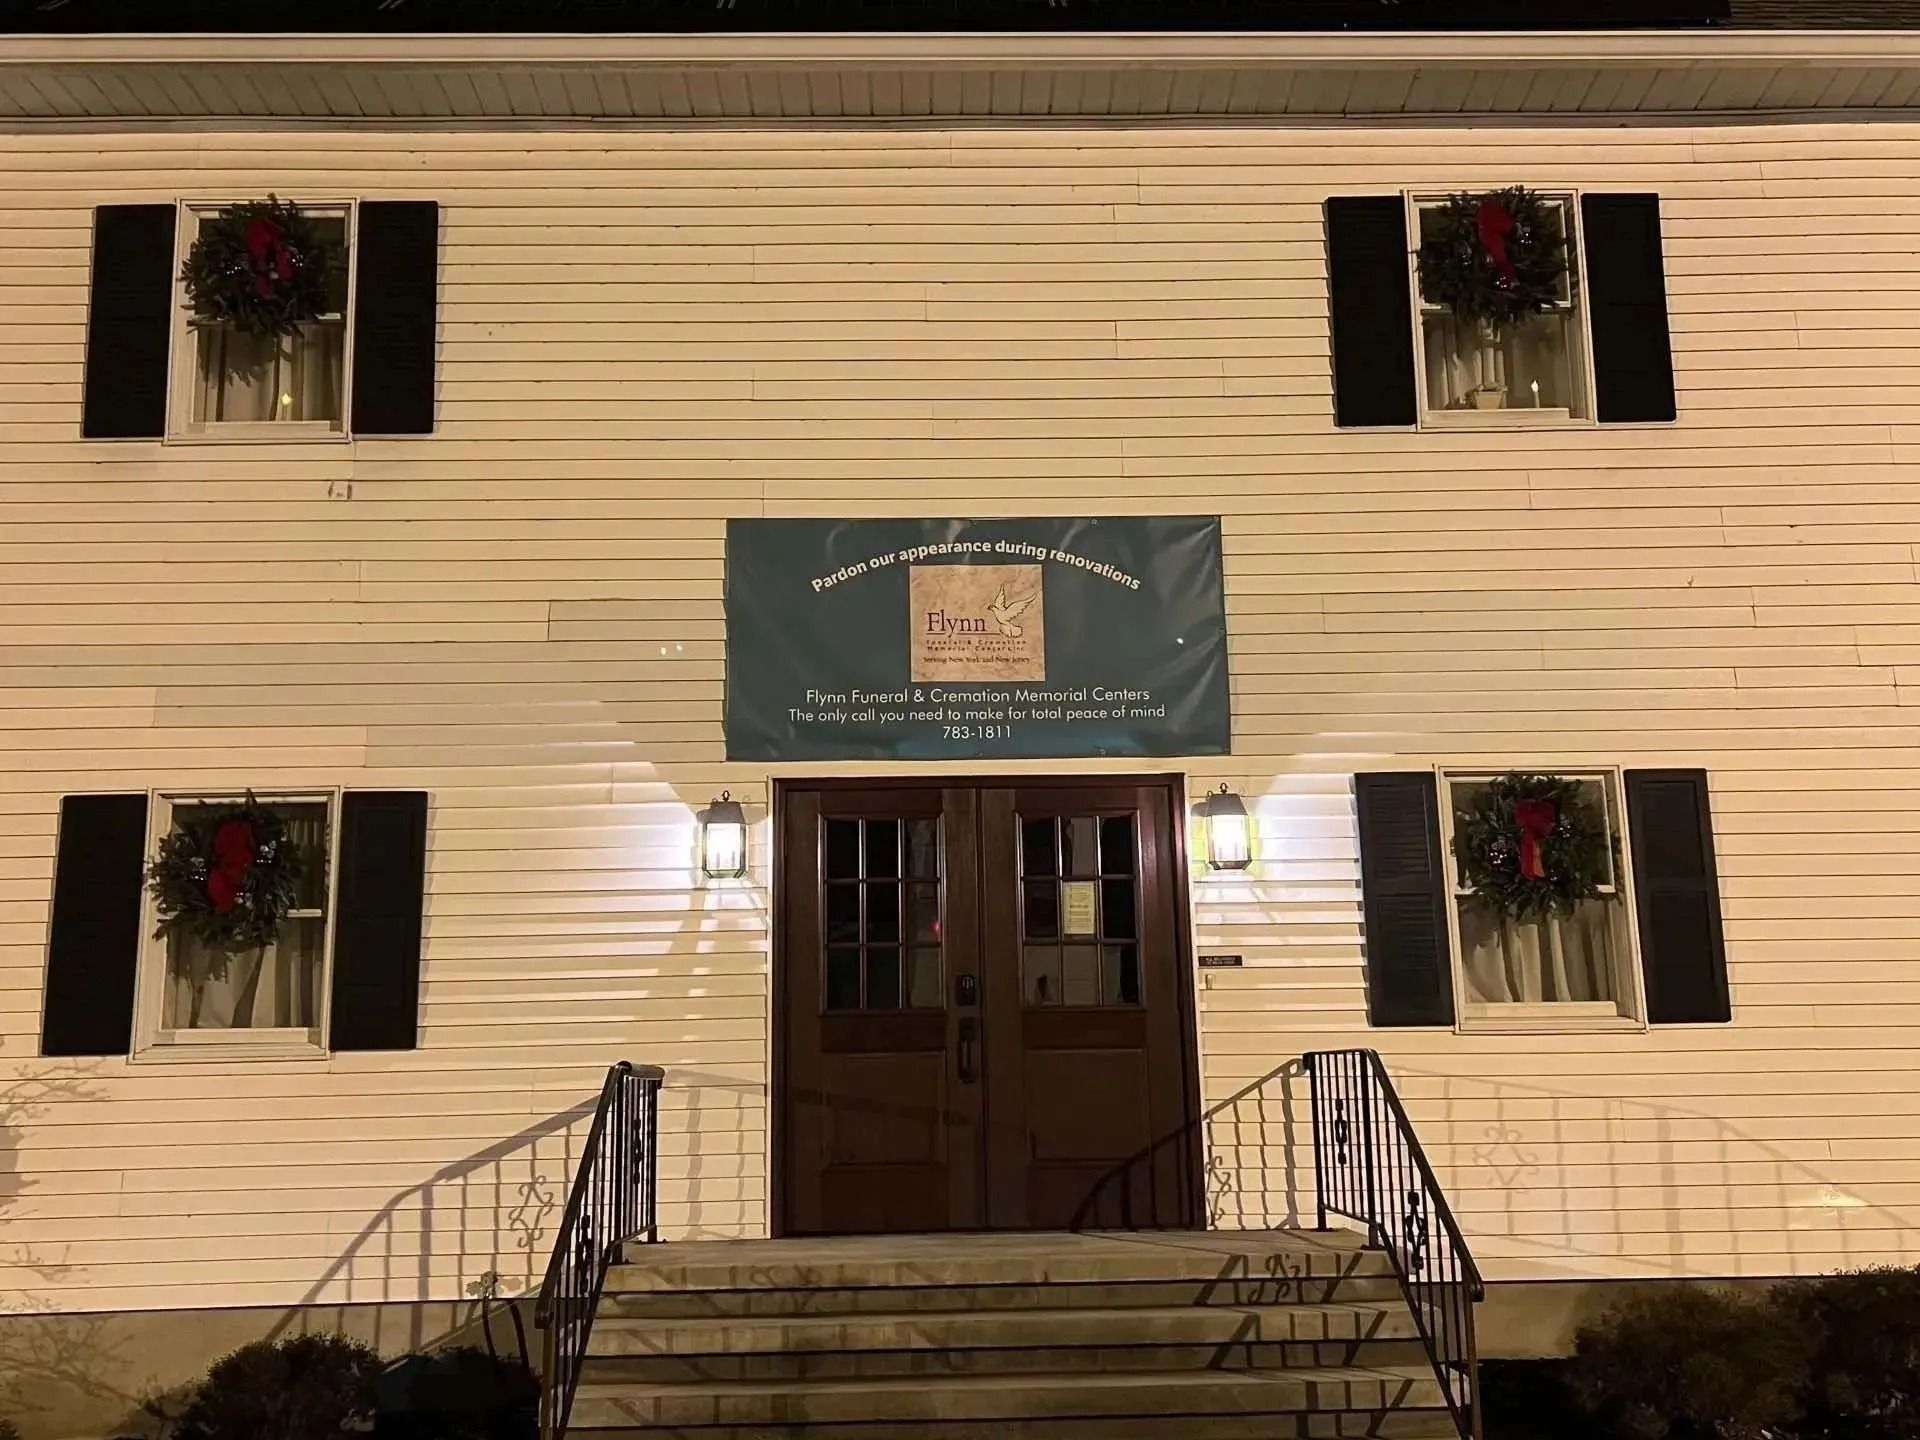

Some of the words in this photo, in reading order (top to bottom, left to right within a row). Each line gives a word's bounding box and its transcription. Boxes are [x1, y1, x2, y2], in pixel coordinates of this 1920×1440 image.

[811, 563, 869, 592] Pardon
[869, 552, 895, 569] our
[899, 540, 991, 562] appearance
[995, 540, 1047, 560] during
[1049, 547, 1142, 590] renovations
[927, 609, 986, 638] Flynn
[806, 690, 846, 705] Flynn
[852, 689, 908, 703] Funeral
[913, 689, 925, 703] &
[930, 689, 1010, 703] Cremation
[1015, 688, 1087, 702] Memorial
[1092, 688, 1151, 701] Centers
[788, 708, 814, 721] The
[818, 707, 847, 724] only
[851, 707, 875, 721] call
[879, 709, 905, 724] you
[909, 706, 943, 721] need
[947, 707, 961, 720] to
[965, 705, 1003, 720] make
[1007, 705, 1027, 720] for
[1031, 706, 1062, 719] total
[1066, 707, 1107, 722] peace
[1111, 705, 1127, 718] of
[1130, 704, 1165, 718] mind
[943, 725, 1012, 740] 783-1811
